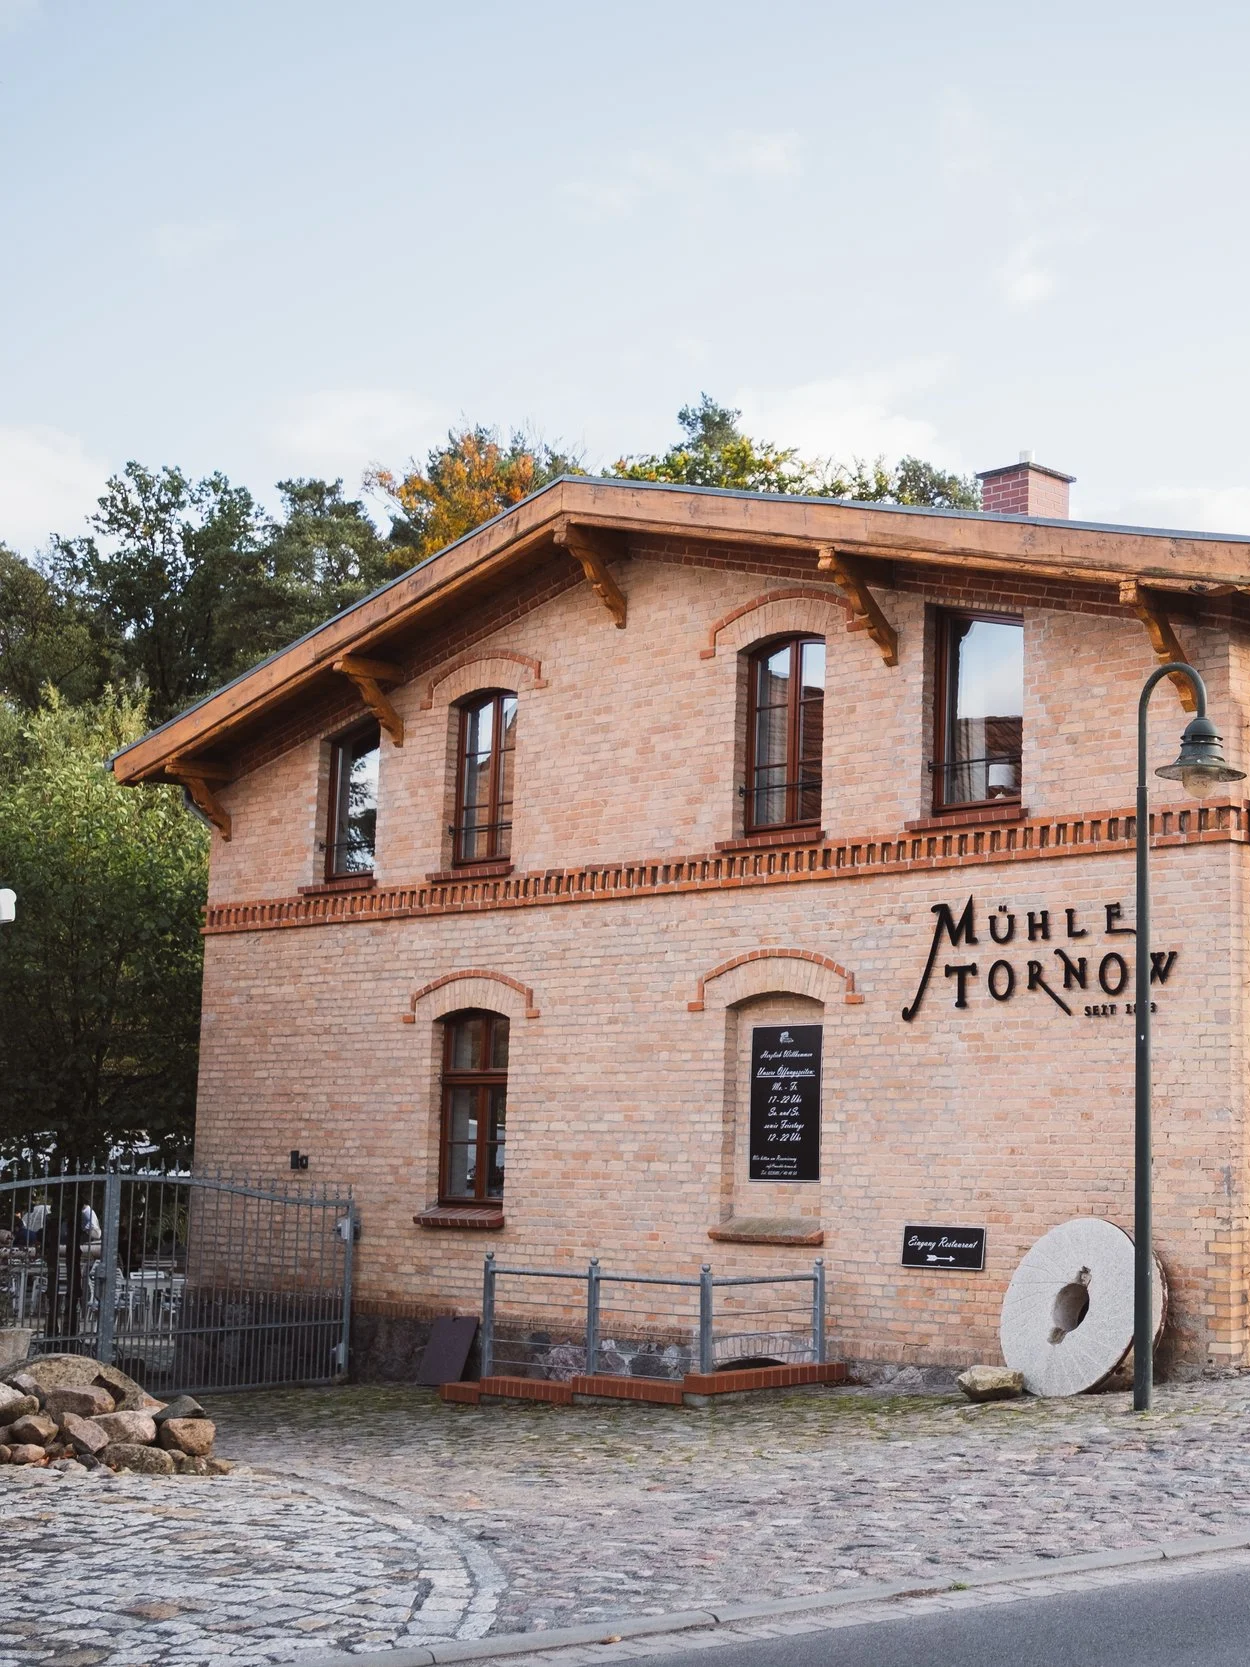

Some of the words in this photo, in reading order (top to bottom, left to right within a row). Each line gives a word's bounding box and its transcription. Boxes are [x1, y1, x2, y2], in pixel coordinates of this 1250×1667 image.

[944, 949, 1177, 1015] TORNOW
[1084, 1003, 1117, 1017] SEIT
[1125, 1002, 1157, 1015] 13
[760, 1050, 783, 1060] Herzlich
[783, 1050, 813, 1058] Willkommen
[757, 1067, 776, 1076] Unsere
[790, 1094, 802, 1104] Uhr
[779, 1108, 791, 1116] und
[780, 1119, 804, 1131] Feiertage
[790, 1132, 802, 1142] Uhr
[908, 1235, 937, 1251] Eingang
[938, 1236, 978, 1248] Restaurant
